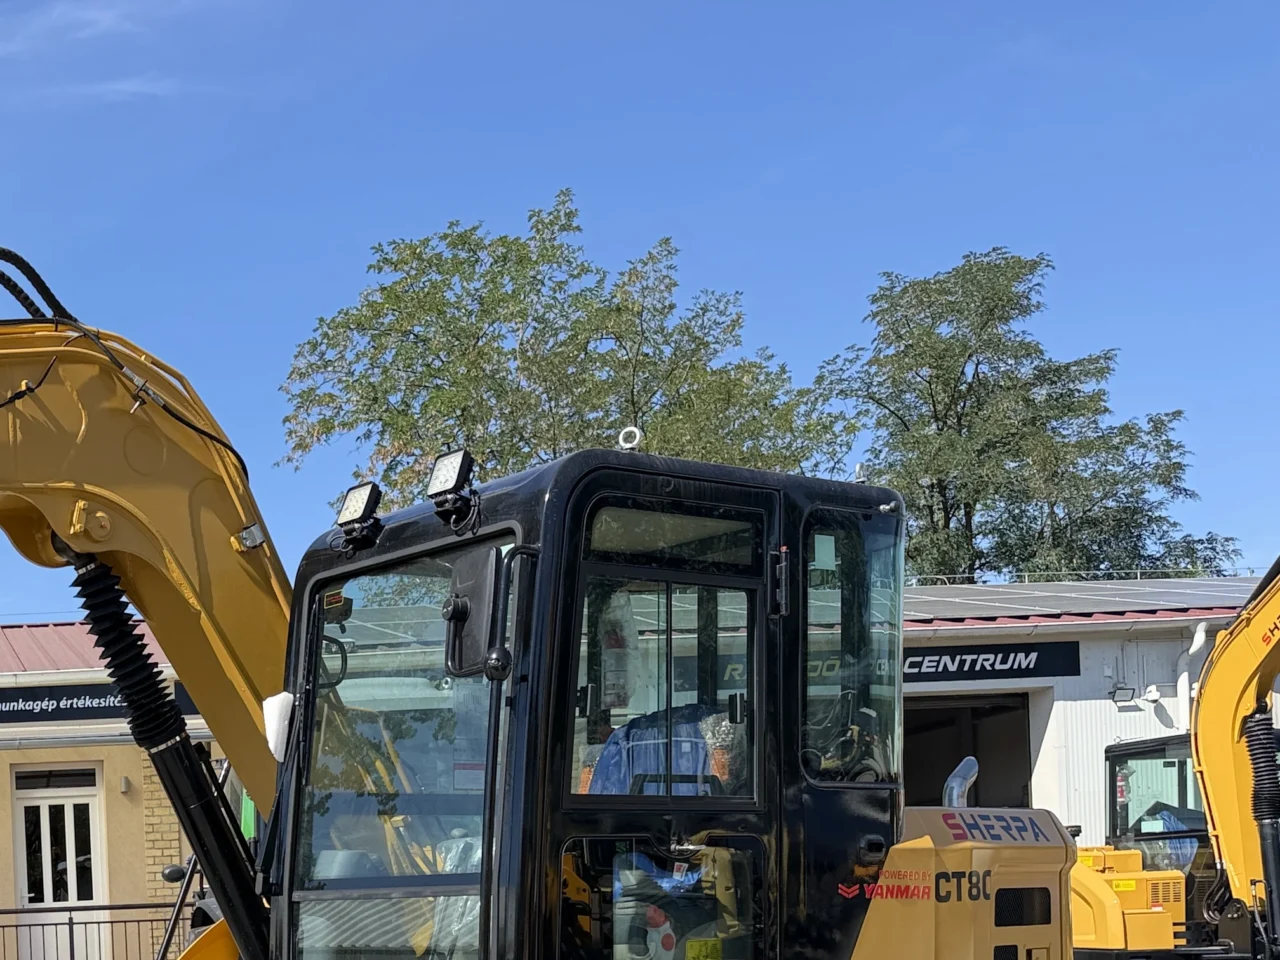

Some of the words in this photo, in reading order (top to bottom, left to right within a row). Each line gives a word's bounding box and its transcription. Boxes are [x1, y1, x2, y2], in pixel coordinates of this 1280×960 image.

[903, 651, 1038, 674] CENTRUM
[941, 812, 1050, 842] SHERPA
[879, 870, 919, 880] POWERED
[921, 869, 932, 880] BY
[863, 883, 931, 900] YANMAR
